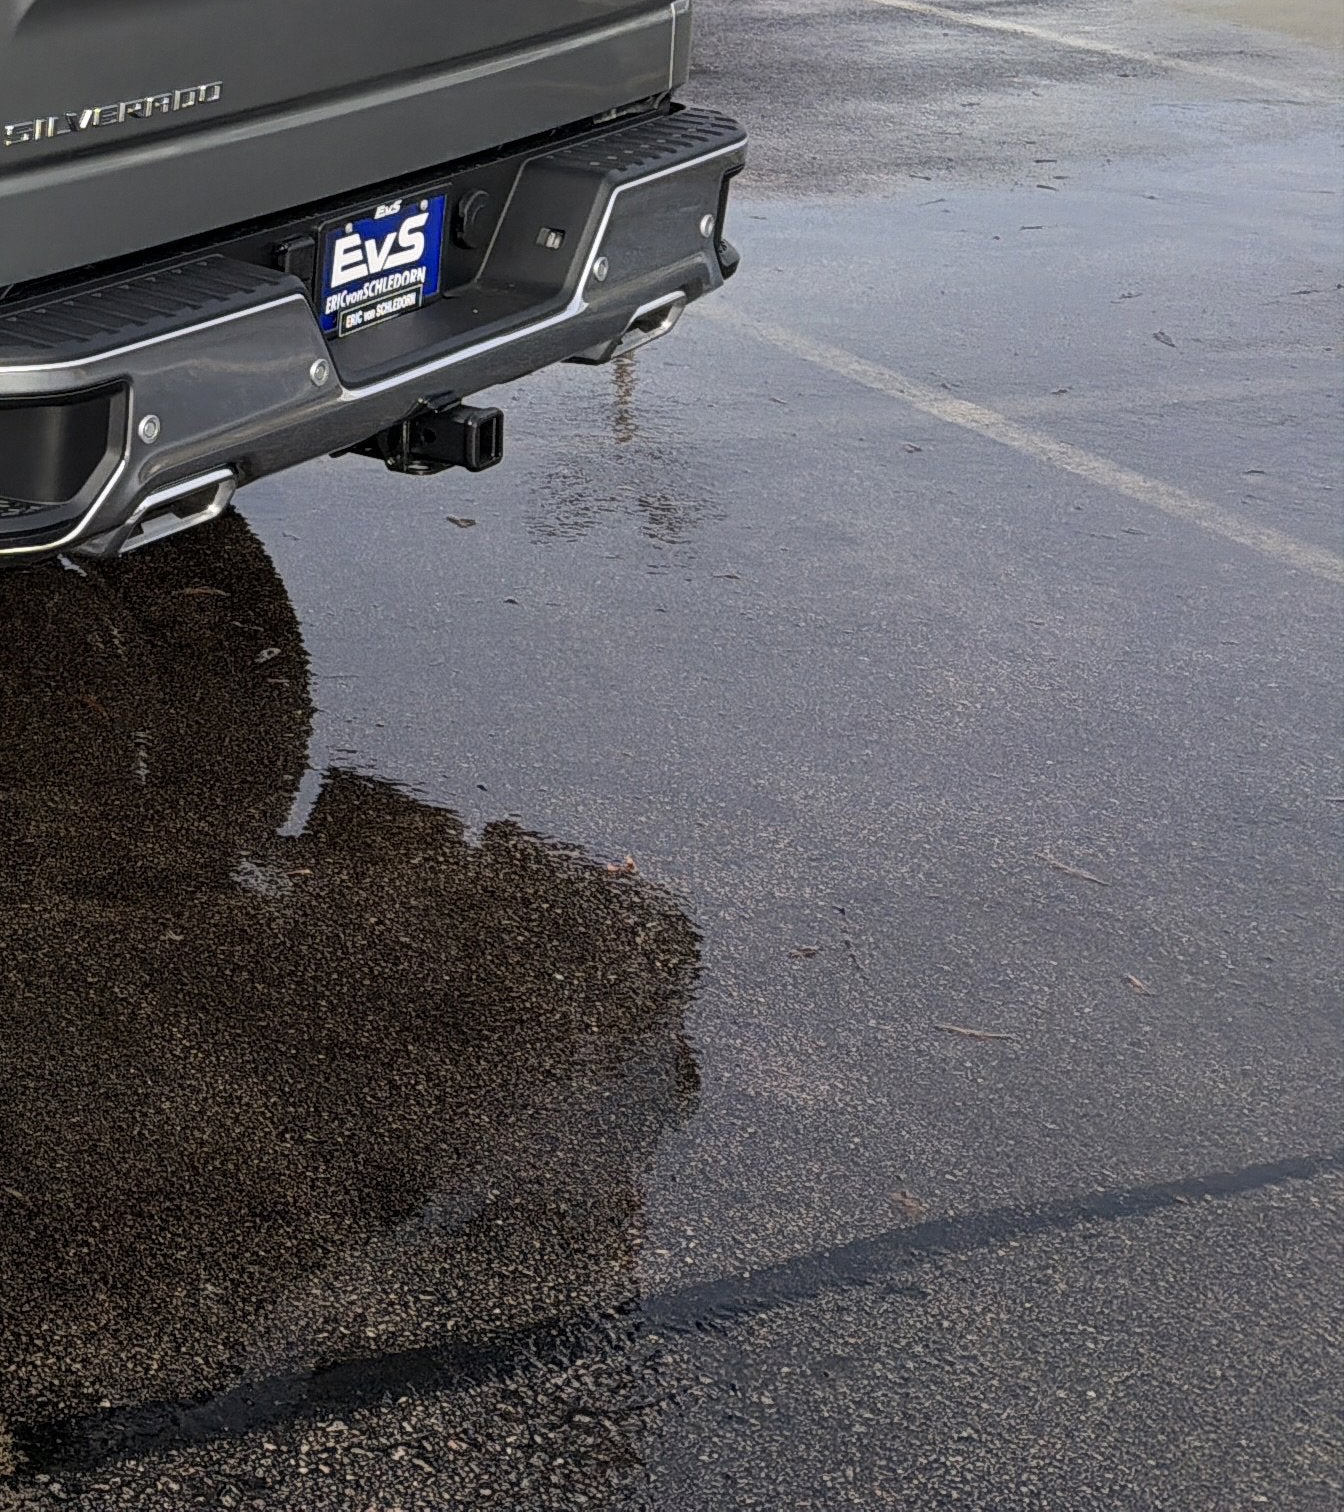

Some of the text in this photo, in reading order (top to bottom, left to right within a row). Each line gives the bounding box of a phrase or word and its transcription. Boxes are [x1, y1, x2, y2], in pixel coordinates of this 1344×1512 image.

[4, 80, 224, 147] SILVERADO
[345, 292, 417, 328] ERIC von SCHLEDORN
